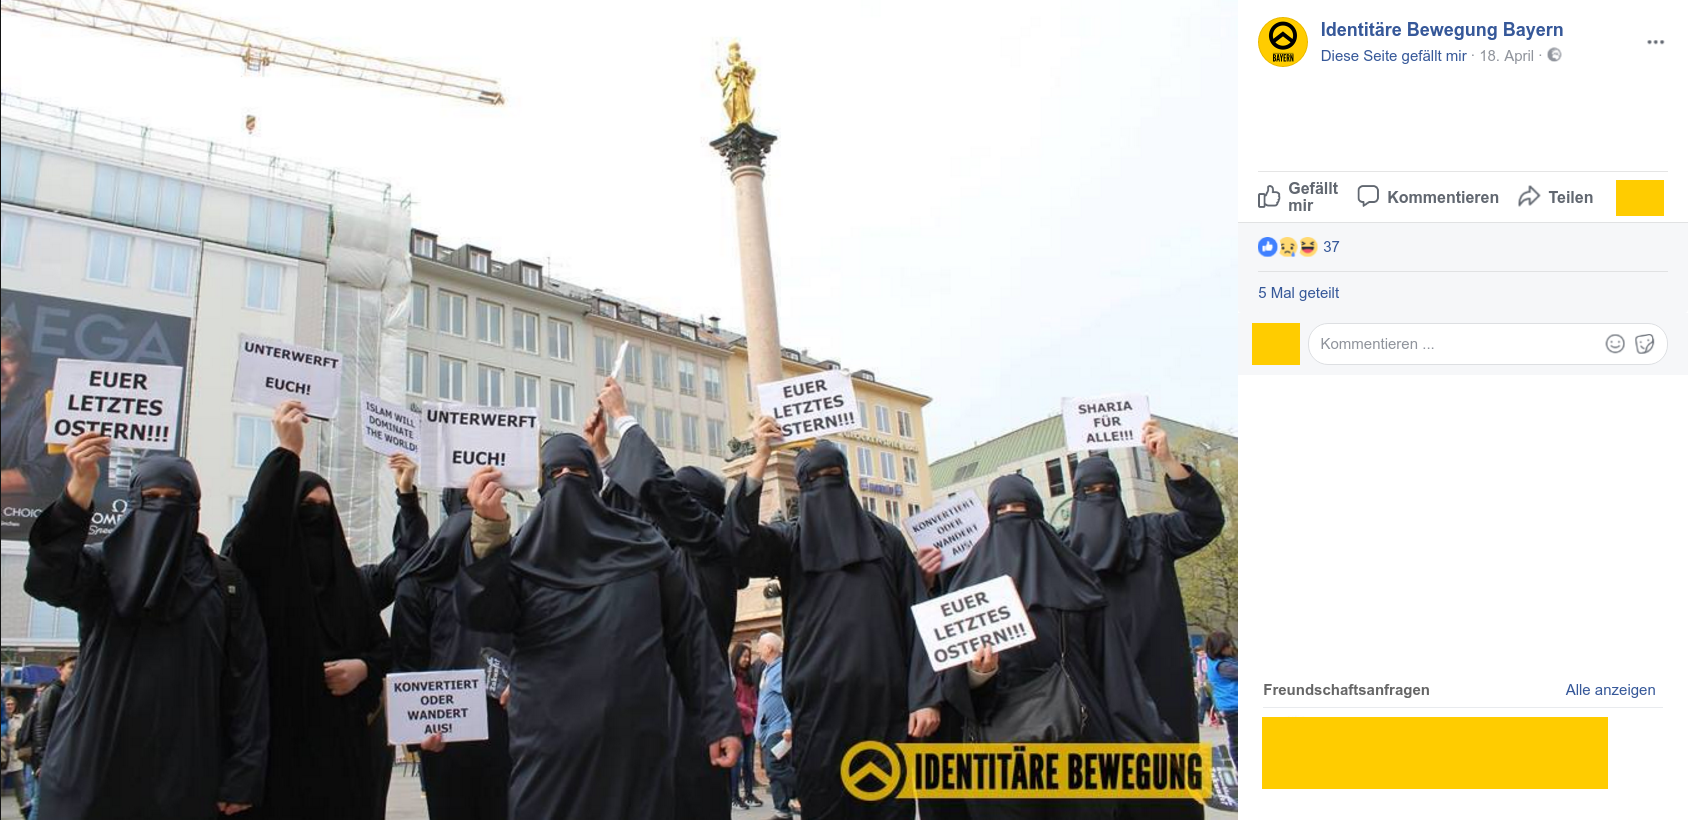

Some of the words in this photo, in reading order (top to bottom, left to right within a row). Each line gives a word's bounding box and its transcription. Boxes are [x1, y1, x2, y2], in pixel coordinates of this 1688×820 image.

[1321, 21, 1402, 37] Identitäre
[1407, 21, 1498, 41] Bewegung
[1503, 21, 1564, 41] Bayern
[1272, 52, 1295, 63] BAYERN
[1321, 49, 1360, 62] Diese
[1364, 49, 1398, 62] Seite
[1401, 49, 1443, 65] gefällt
[1446, 49, 1468, 62] mir
[1480, 49, 1500, 62] 18.
[1503, 49, 1534, 65] April
[1288, 181, 1339, 195] Gefällt
[1288, 198, 1314, 212] mir
[1387, 190, 1500, 204] Kommentieren
[1548, 190, 1594, 204] Teilen
[1323, 240, 1340, 253] 37
[1258, 286, 1267, 299] 5
[1271, 286, 1295, 299] Mal
[1298, 286, 1340, 302] geteilt
[1321, 337, 1418, 350] Kommentieren
[244, 341, 339, 369] UNTERWERFT
[89, 371, 148, 390] EUER
[265, 376, 311, 395] EUCH!
[783, 379, 827, 398] EUER
[68, 394, 163, 416] LETZTES
[773, 394, 844, 419] LETZTES
[1078, 401, 1133, 415] SHARIA
[366, 401, 393, 419] ISLAM
[394, 412, 416, 428] WILL
[427, 409, 537, 428] UNTERWERFT
[1093, 414, 1121, 428] FÜR
[54, 419, 169, 442] OSTERN!!!
[369, 415, 414, 439] DOMINATE
[781, 412, 855, 437] STERN!!!
[366, 426, 382, 440] THE
[384, 433, 418, 453] WORLD!
[1086, 430, 1134, 443] ALLE!!!
[452, 450, 506, 466] EUCH!
[912, 499, 974, 533] KONVERTIERT
[936, 518, 963, 535] ODER
[933, 523, 978, 549] WANDERT
[940, 591, 989, 617] EUER
[933, 605, 1011, 641] LETZTES
[934, 623, 1027, 663] OSTERN!!!
[394, 679, 479, 693] KONVERTIERT
[1263, 683, 1430, 699] Freundschaftsanfragen
[1565, 683, 1591, 696] Alle
[1594, 683, 1656, 699] anzeigen
[420, 694, 454, 706] ODER
[407, 708, 468, 721] WANDERT
[424, 723, 453, 735] AUS!
